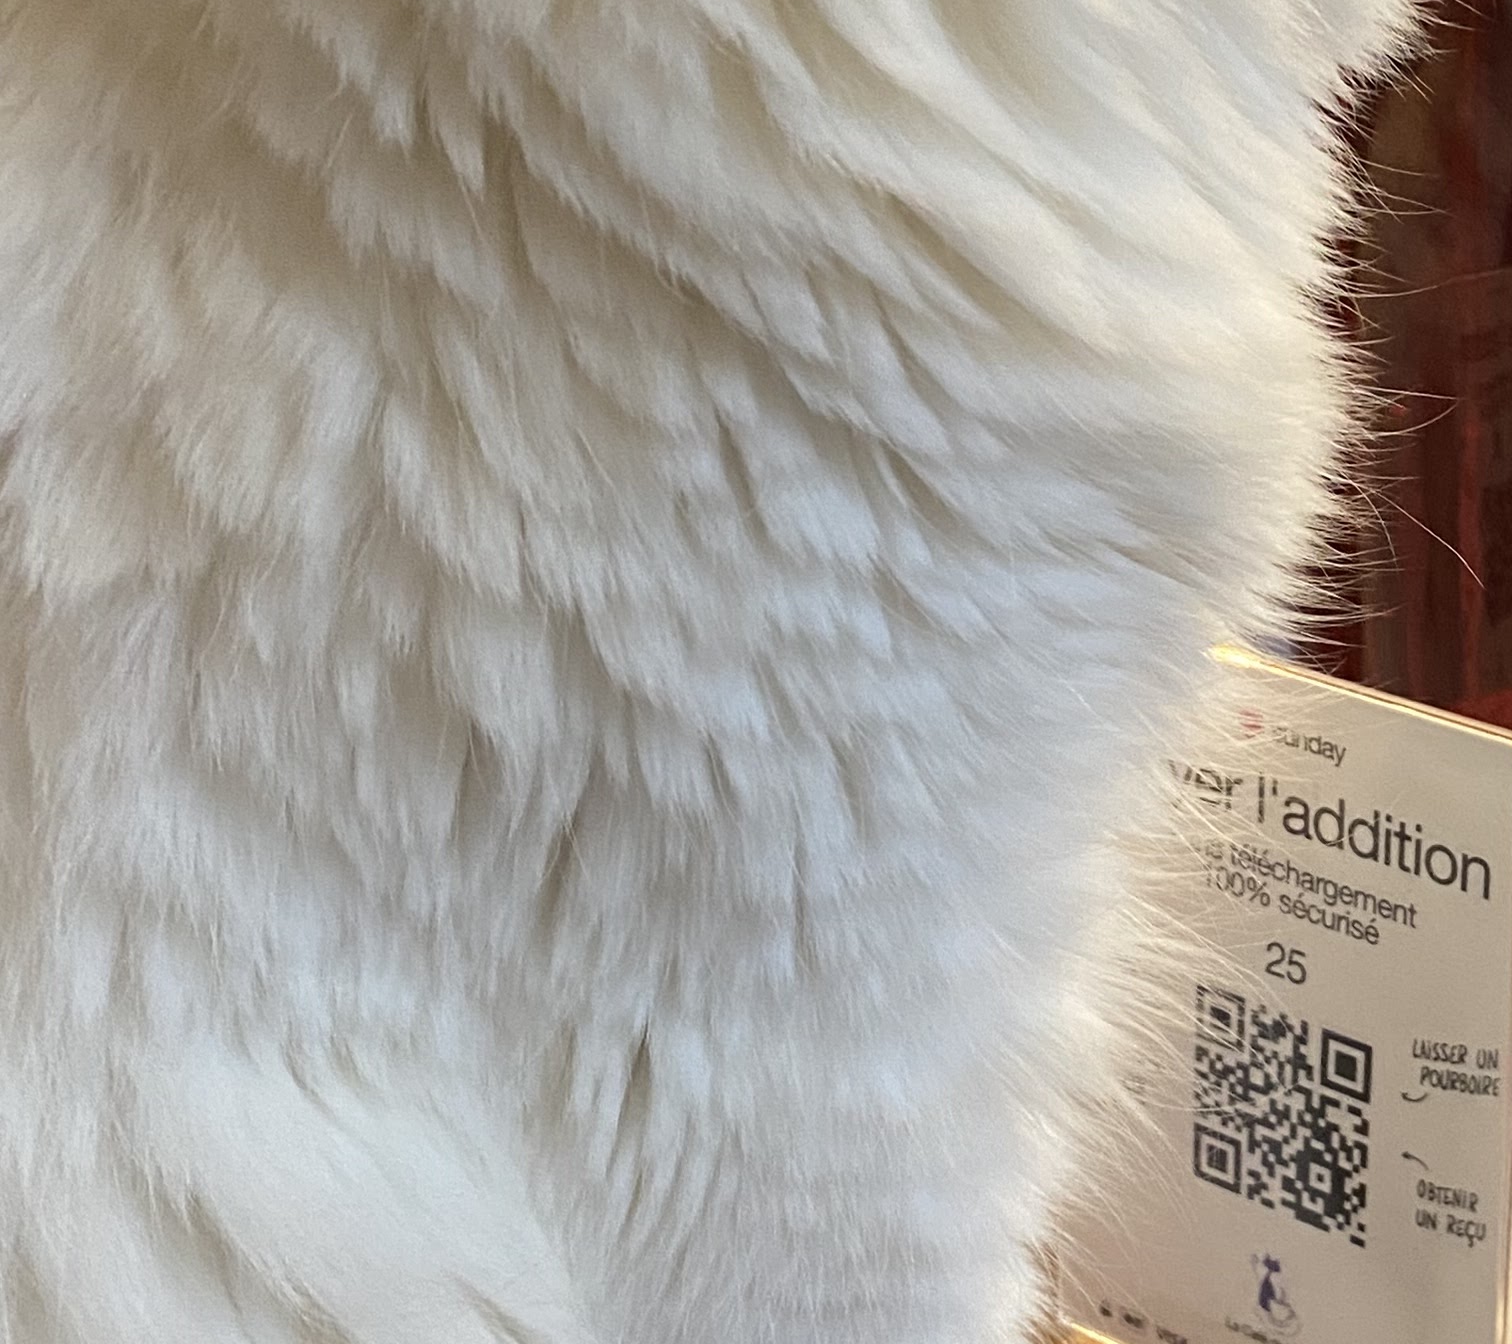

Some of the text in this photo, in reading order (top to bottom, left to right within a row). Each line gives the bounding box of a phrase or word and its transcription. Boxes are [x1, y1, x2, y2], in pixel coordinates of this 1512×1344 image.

[1257, 772, 1491, 900] l'addition
[1229, 842, 1418, 929] téléchargement
[1279, 893, 1380, 946] sécurisé
[1265, 942, 1307, 985] 25
[1476, 1048, 1499, 1070] UN
[1420, 1065, 1501, 1096] POURBOIRE
[1416, 1178, 1479, 1213] OBTENIR
[1415, 1208, 1487, 1249] UN REÇU
